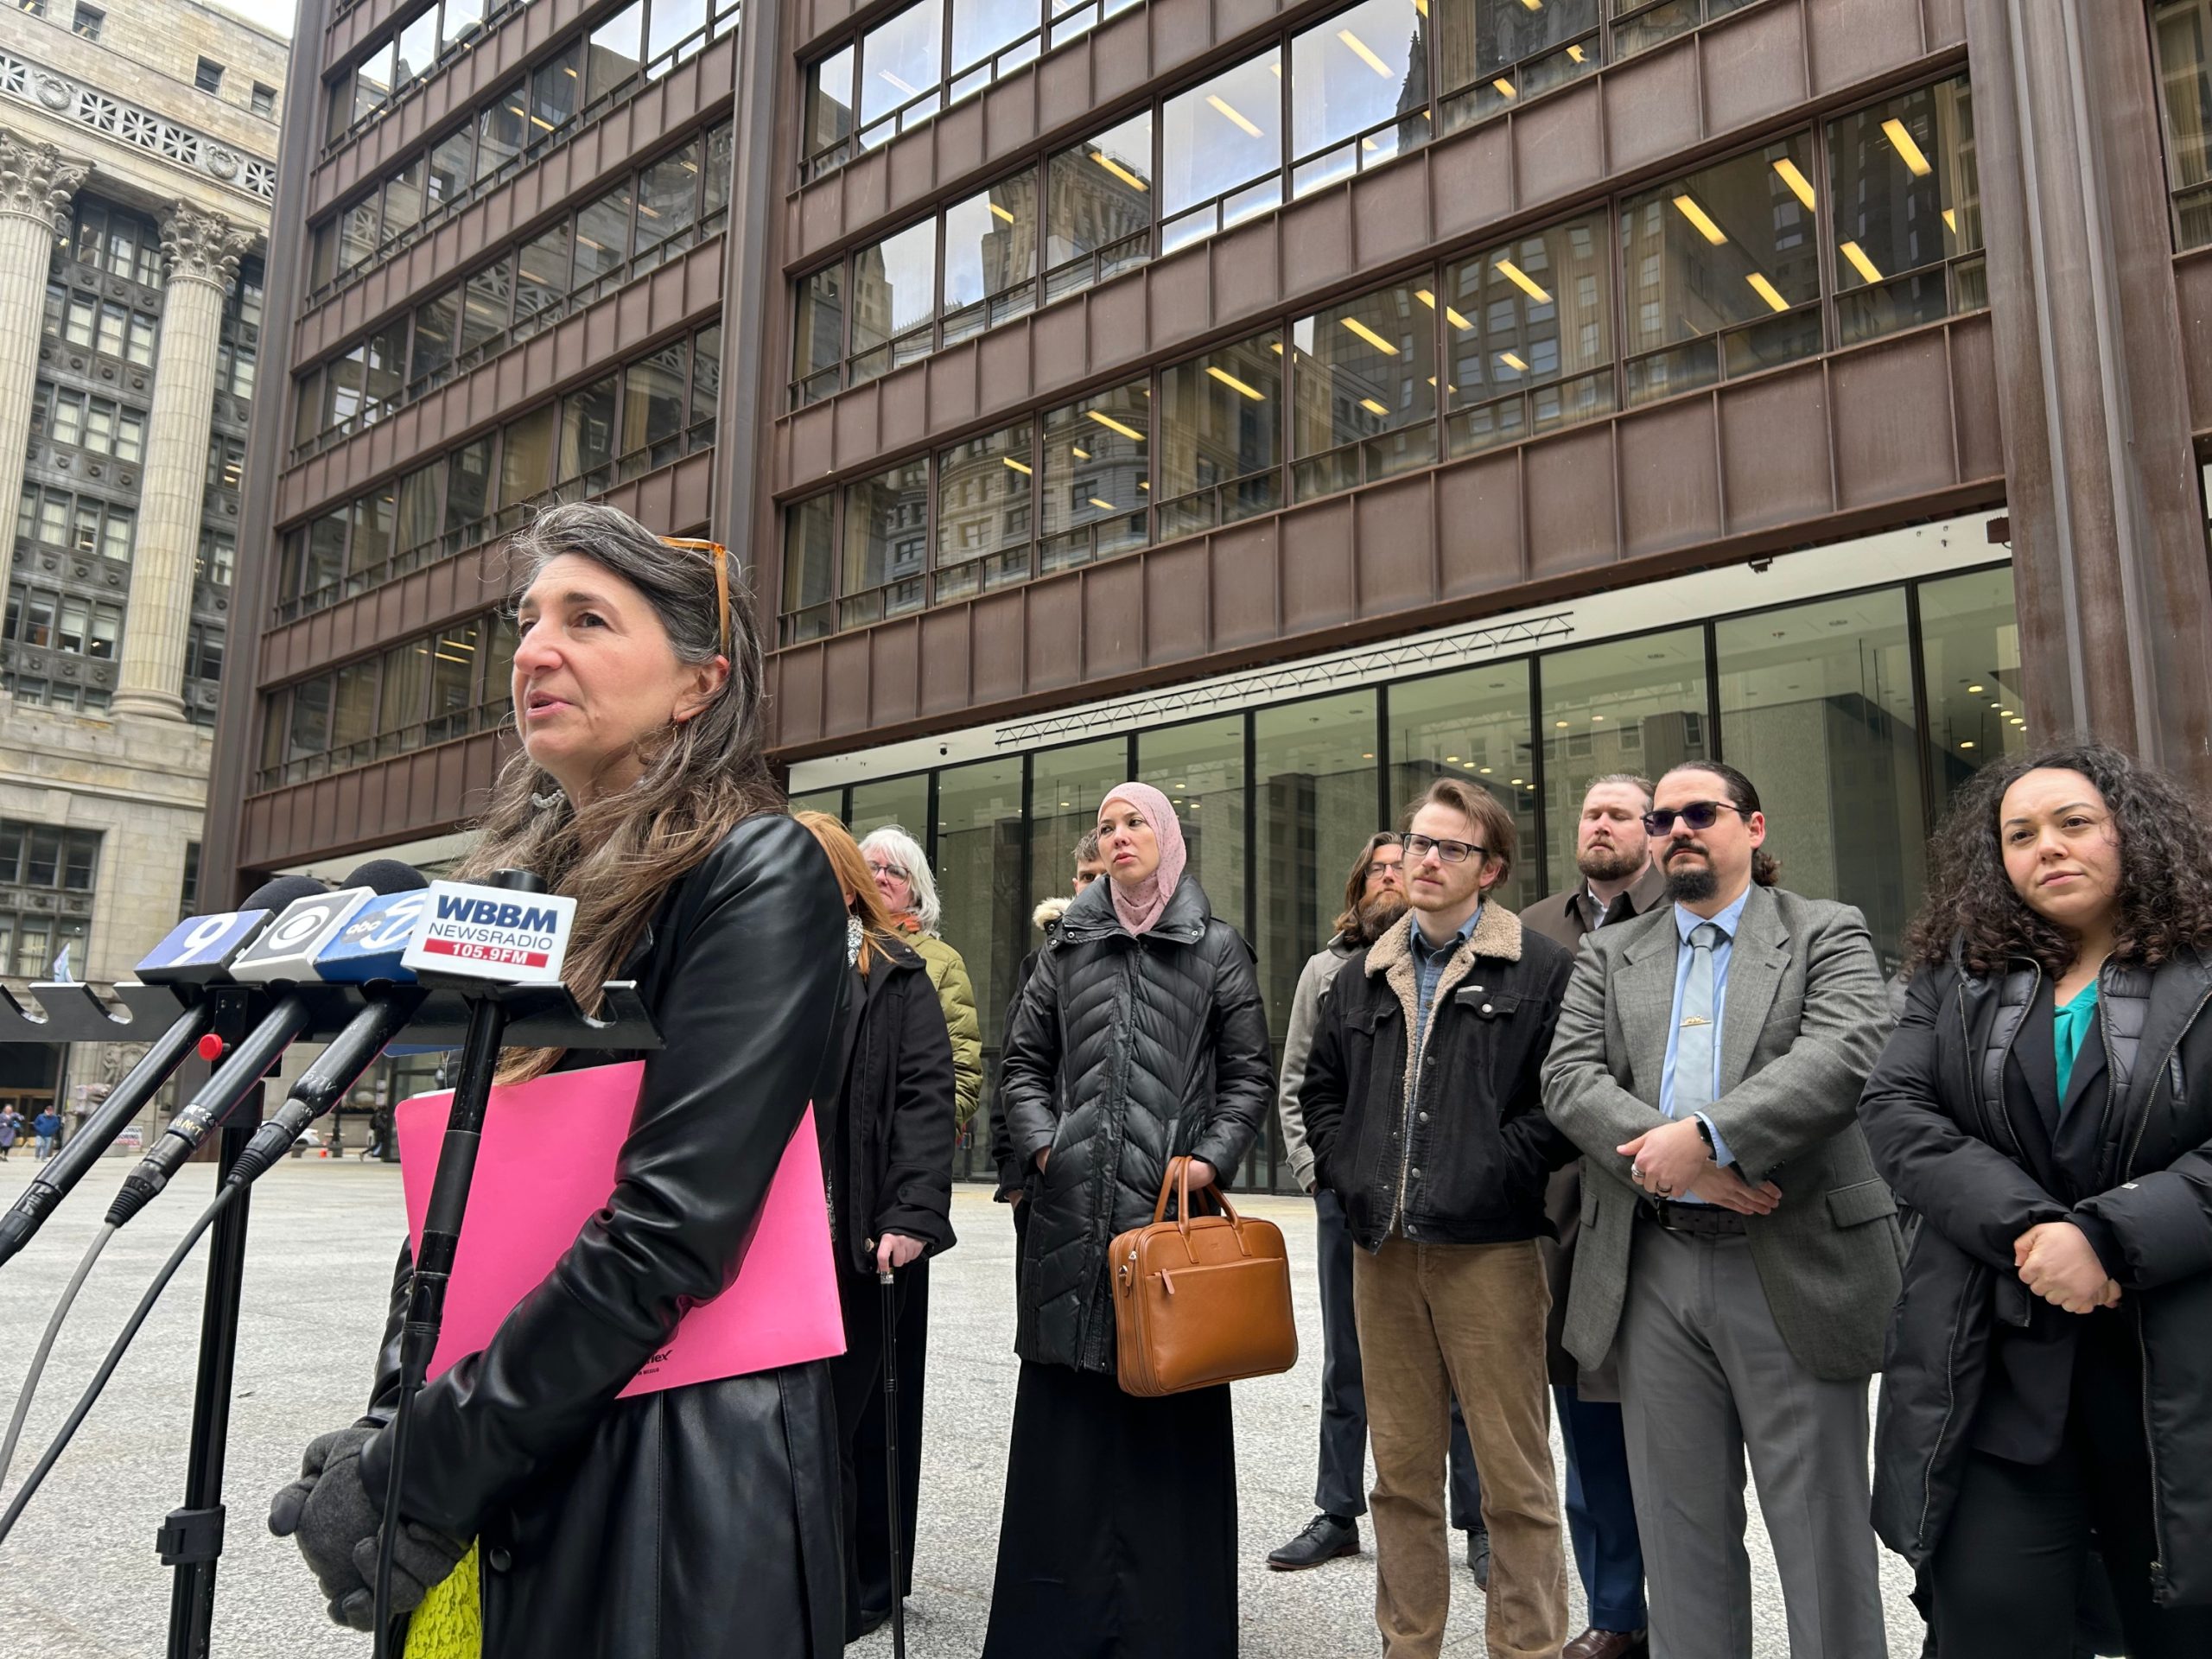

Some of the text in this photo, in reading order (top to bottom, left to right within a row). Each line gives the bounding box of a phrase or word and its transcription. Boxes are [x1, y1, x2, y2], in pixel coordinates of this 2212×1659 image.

[346, 920, 382, 935] abc
[437, 894, 557, 934] WBBM
[167, 912, 238, 966] 9
[429, 922, 553, 950] NEWSRADIO
[453, 943, 529, 964] 105.9FM
